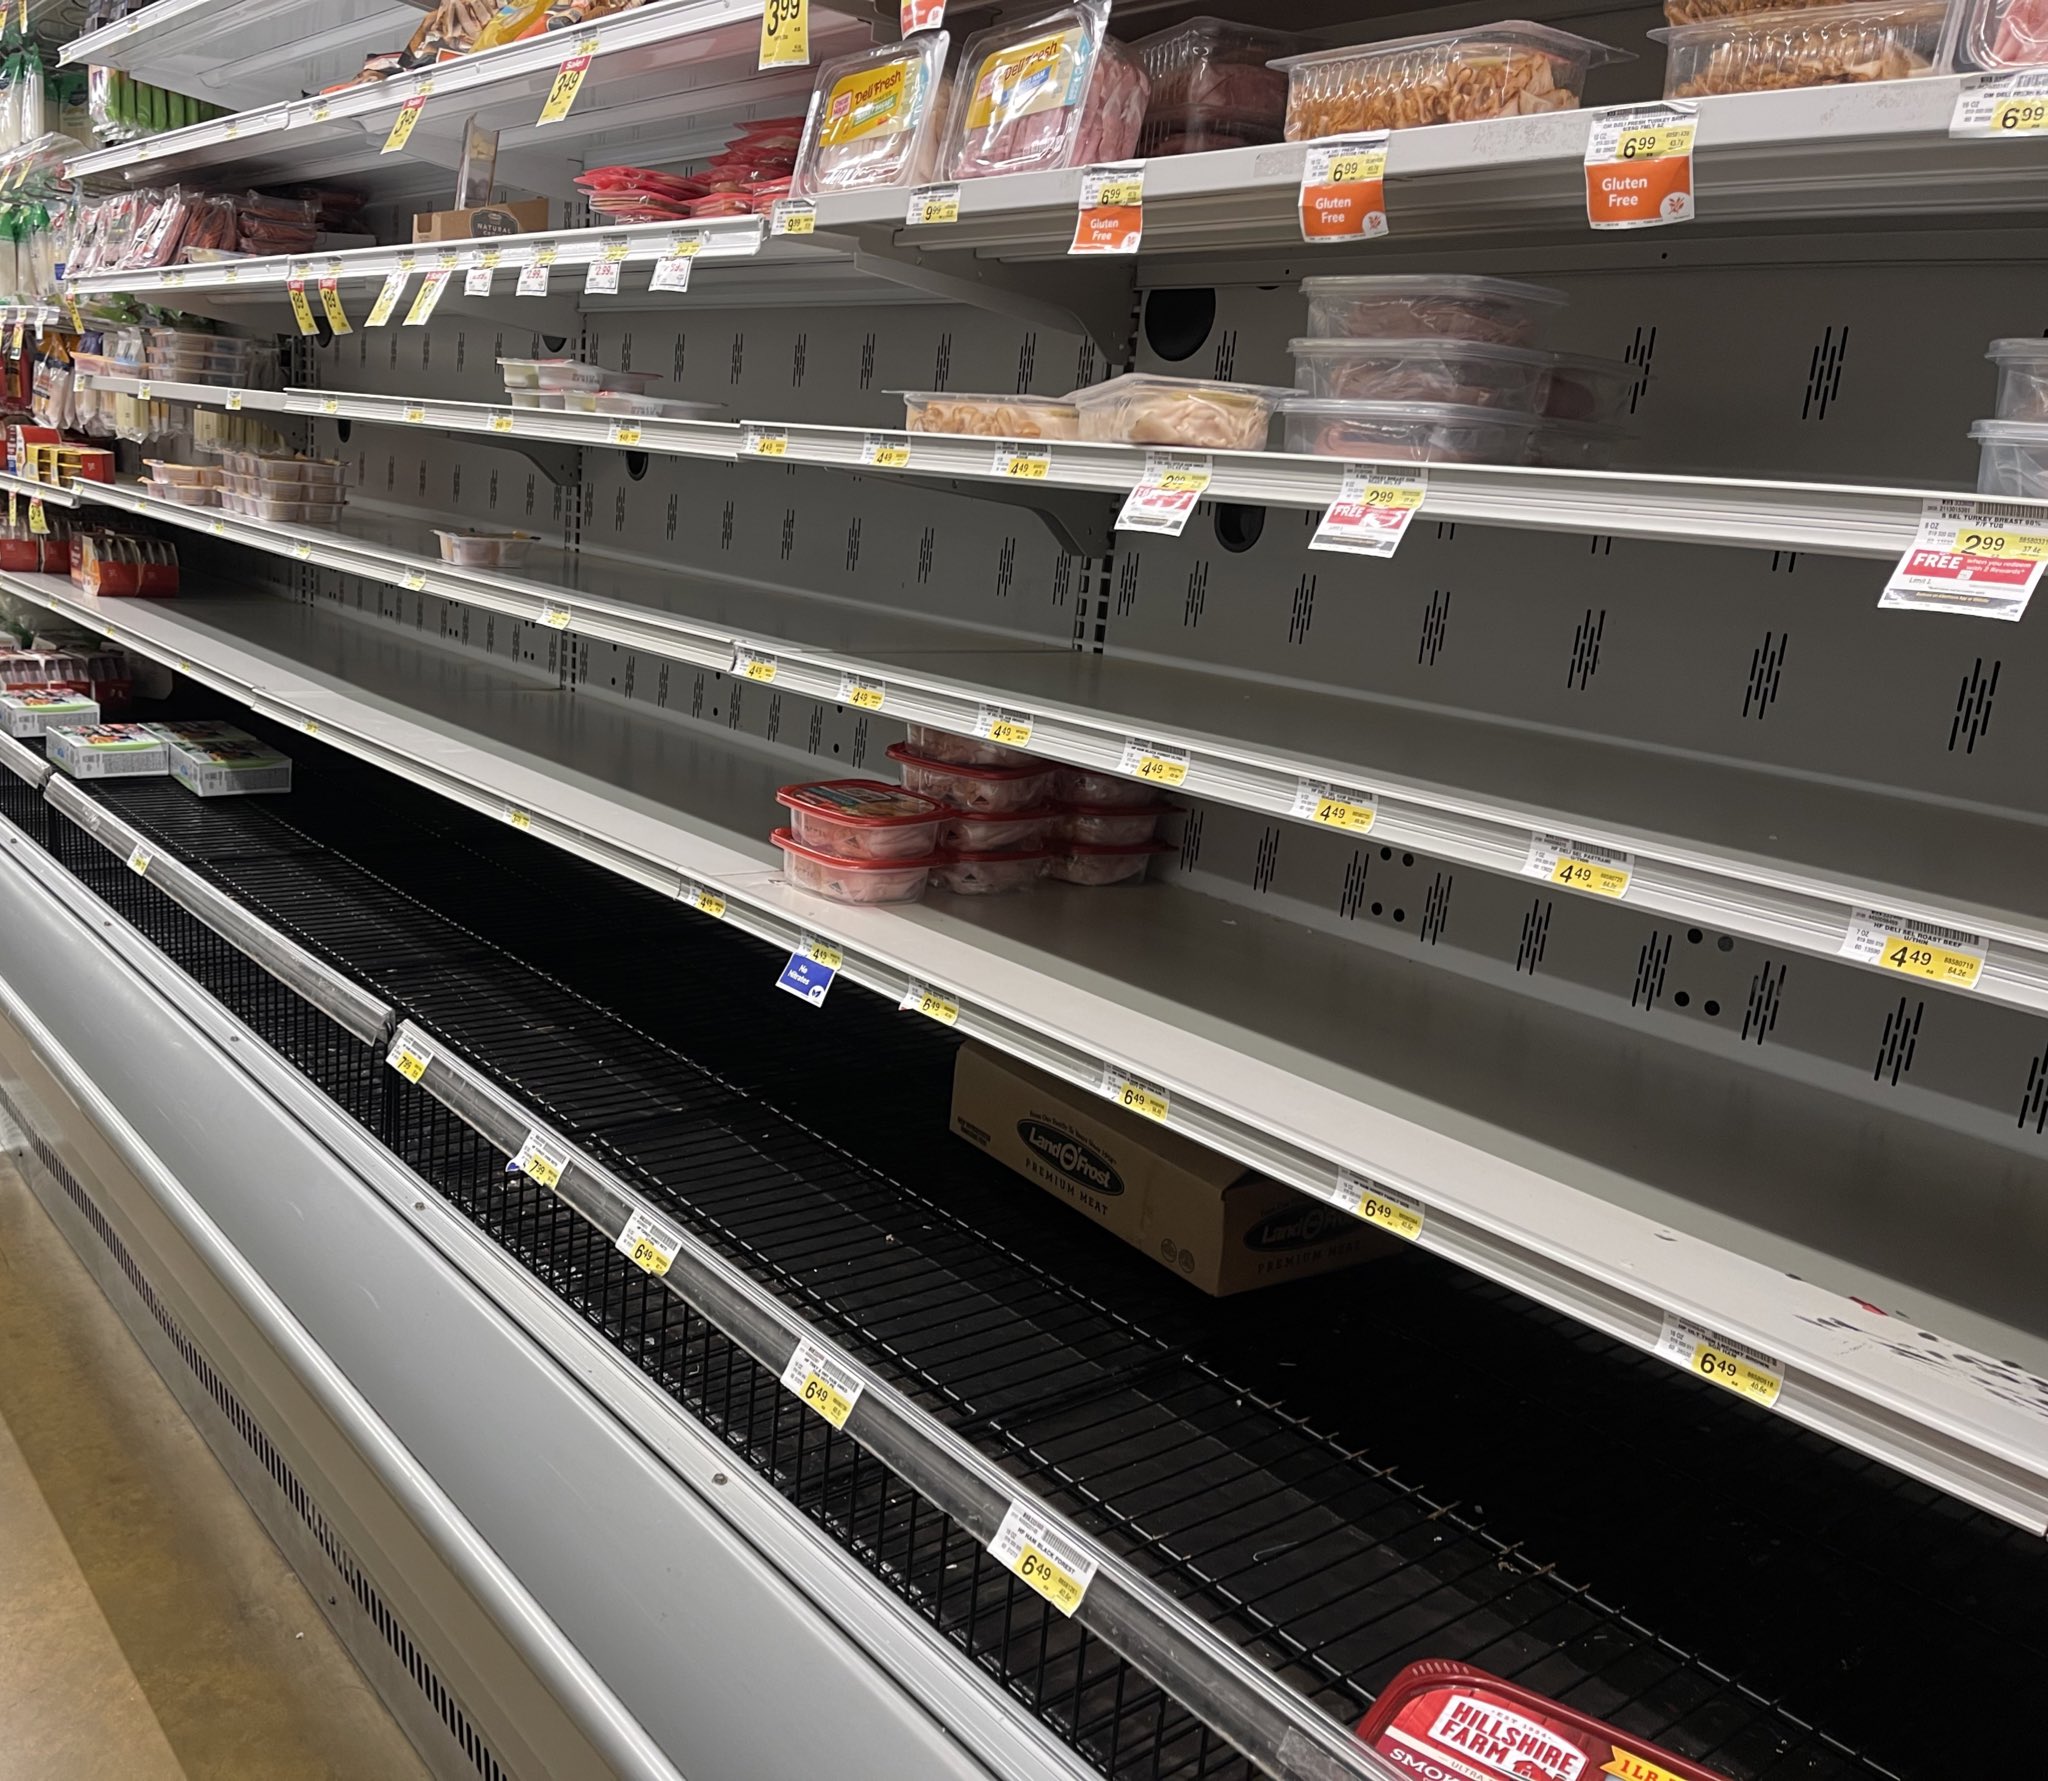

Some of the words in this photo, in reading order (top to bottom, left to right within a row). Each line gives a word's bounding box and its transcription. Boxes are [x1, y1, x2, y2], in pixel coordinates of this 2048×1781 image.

[550, 70, 580, 103] 349
[854, 84, 874, 105] Deli
[874, 70, 901, 95] Fresh
[1623, 136, 1656, 159] 699
[1333, 162, 1358, 182] 699
[1602, 177, 1648, 192] Gluten
[1102, 188, 1120, 205] 699
[1315, 198, 1351, 210] Gluten
[1608, 194, 1638, 208] Free
[1090, 218, 1118, 229] Gluten
[1322, 212, 1344, 224] Free
[477, 223, 512, 234] NATURAL
[1092, 230, 1112, 240] Free
[876, 452, 892, 464] 449
[1010, 462, 1028, 476] 449
[1366, 490, 1394, 506] 299
[1334, 504, 1366, 517] FREE
[1930, 522, 1939, 530] OZ
[1964, 514, 1992, 522] TURKEY
[1994, 516, 2022, 525] BREAST
[1961, 534, 2005, 556] 299
[1912, 552, 1964, 570] FREE
[1966, 558, 1986, 566] when
[1988, 560, 2002, 568] you
[2003, 560, 2032, 569] redeem
[994, 725, 1011, 739] 449
[1142, 761, 1163, 776] 449
[1320, 804, 1345, 821] 449
[1560, 864, 1592, 883] 449
[1884, 925, 1901, 933] DELI
[1901, 929, 1915, 937] SEL
[1916, 932, 1941, 943] ROAST
[1942, 939, 1962, 948] BEEF
[1890, 946, 1932, 967] 449
[922, 998, 940, 1011] 649
[1124, 1090, 1145, 1105] 649
[529, 1160, 545, 1175] 799
[1025, 1158, 1075, 1196] PREMIUM
[1080, 1191, 1108, 1215] MEAT
[1365, 1199, 1391, 1218] 649
[635, 1244, 652, 1260] 649
[1700, 1352, 1736, 1376] 649
[806, 1382, 828, 1402] 649
[1017, 1526, 1025, 1536] HF
[1024, 1532, 1037, 1545] HAM
[1036, 1541, 1055, 1559] BLACK
[1053, 1555, 1075, 1575] FOREST
[1022, 1555, 1051, 1580] 649
[1439, 1719, 1510, 1765] FARM
[1450, 1701, 1579, 1776] HILLSHIRE
[1620, 1760, 1630, 1773] 1
